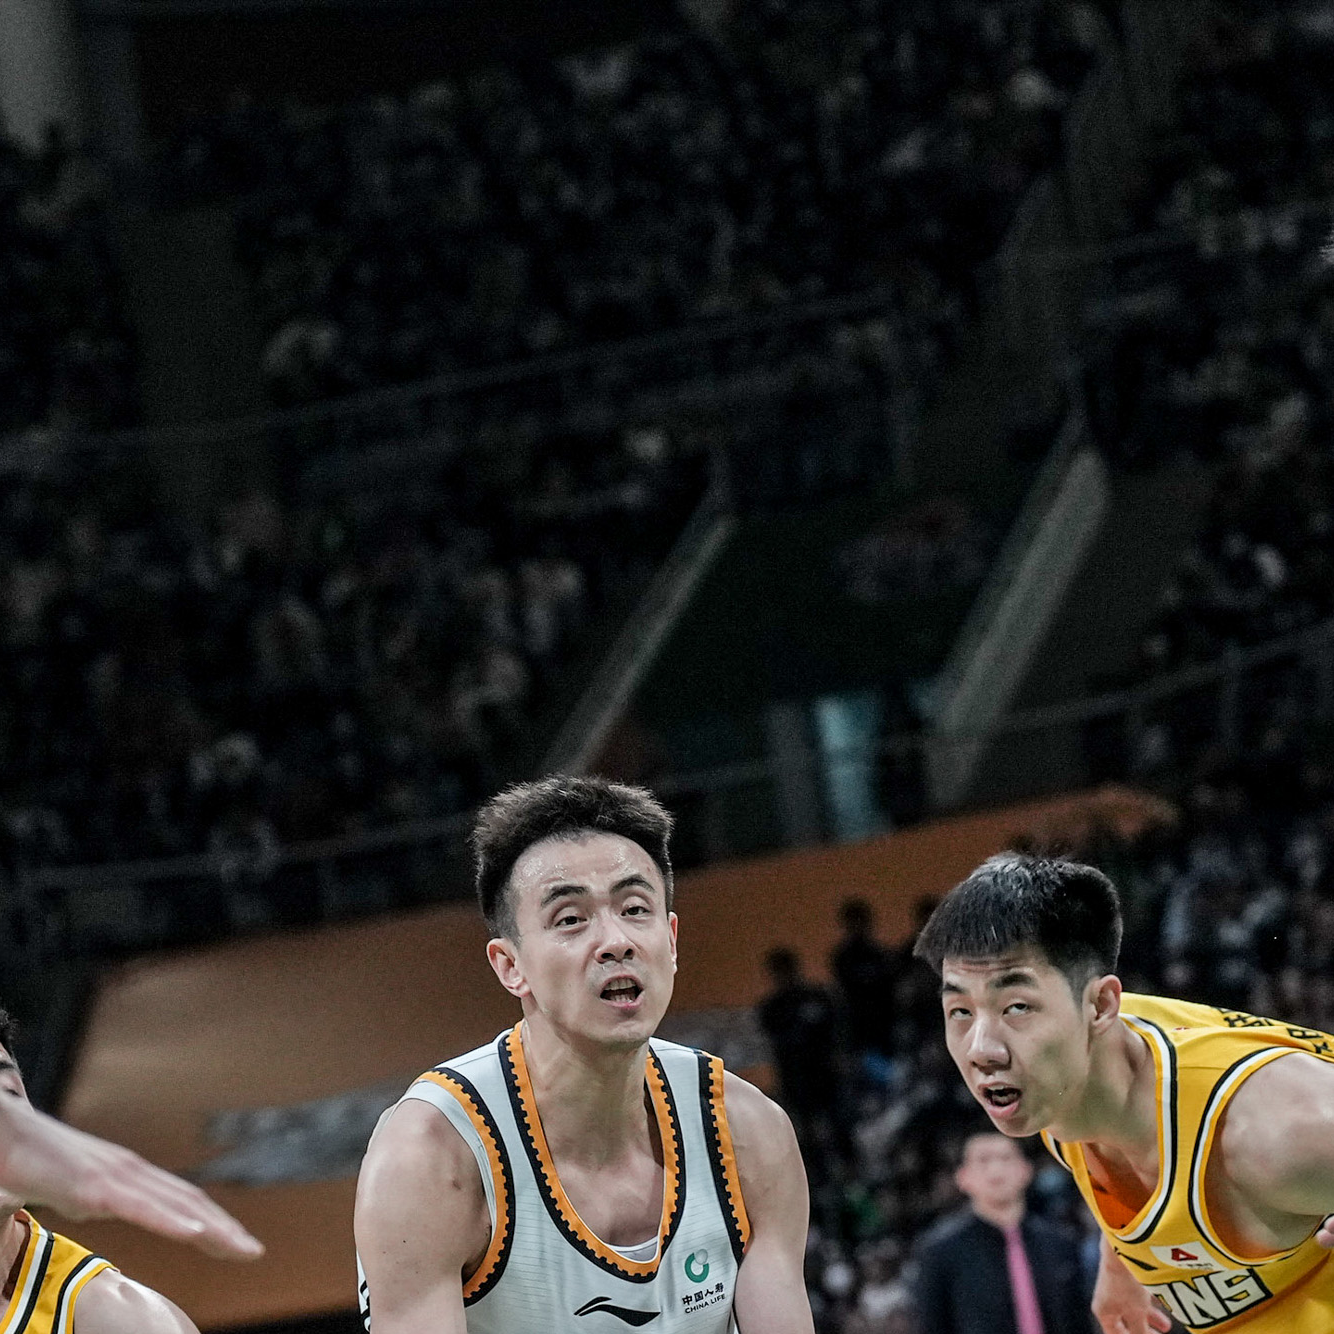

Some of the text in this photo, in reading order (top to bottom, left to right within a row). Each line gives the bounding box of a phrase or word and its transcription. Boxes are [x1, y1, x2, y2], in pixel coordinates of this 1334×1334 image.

[681, 1282, 724, 1306] 中国人寿
[684, 1293, 726, 1314] CHINA LIFE
